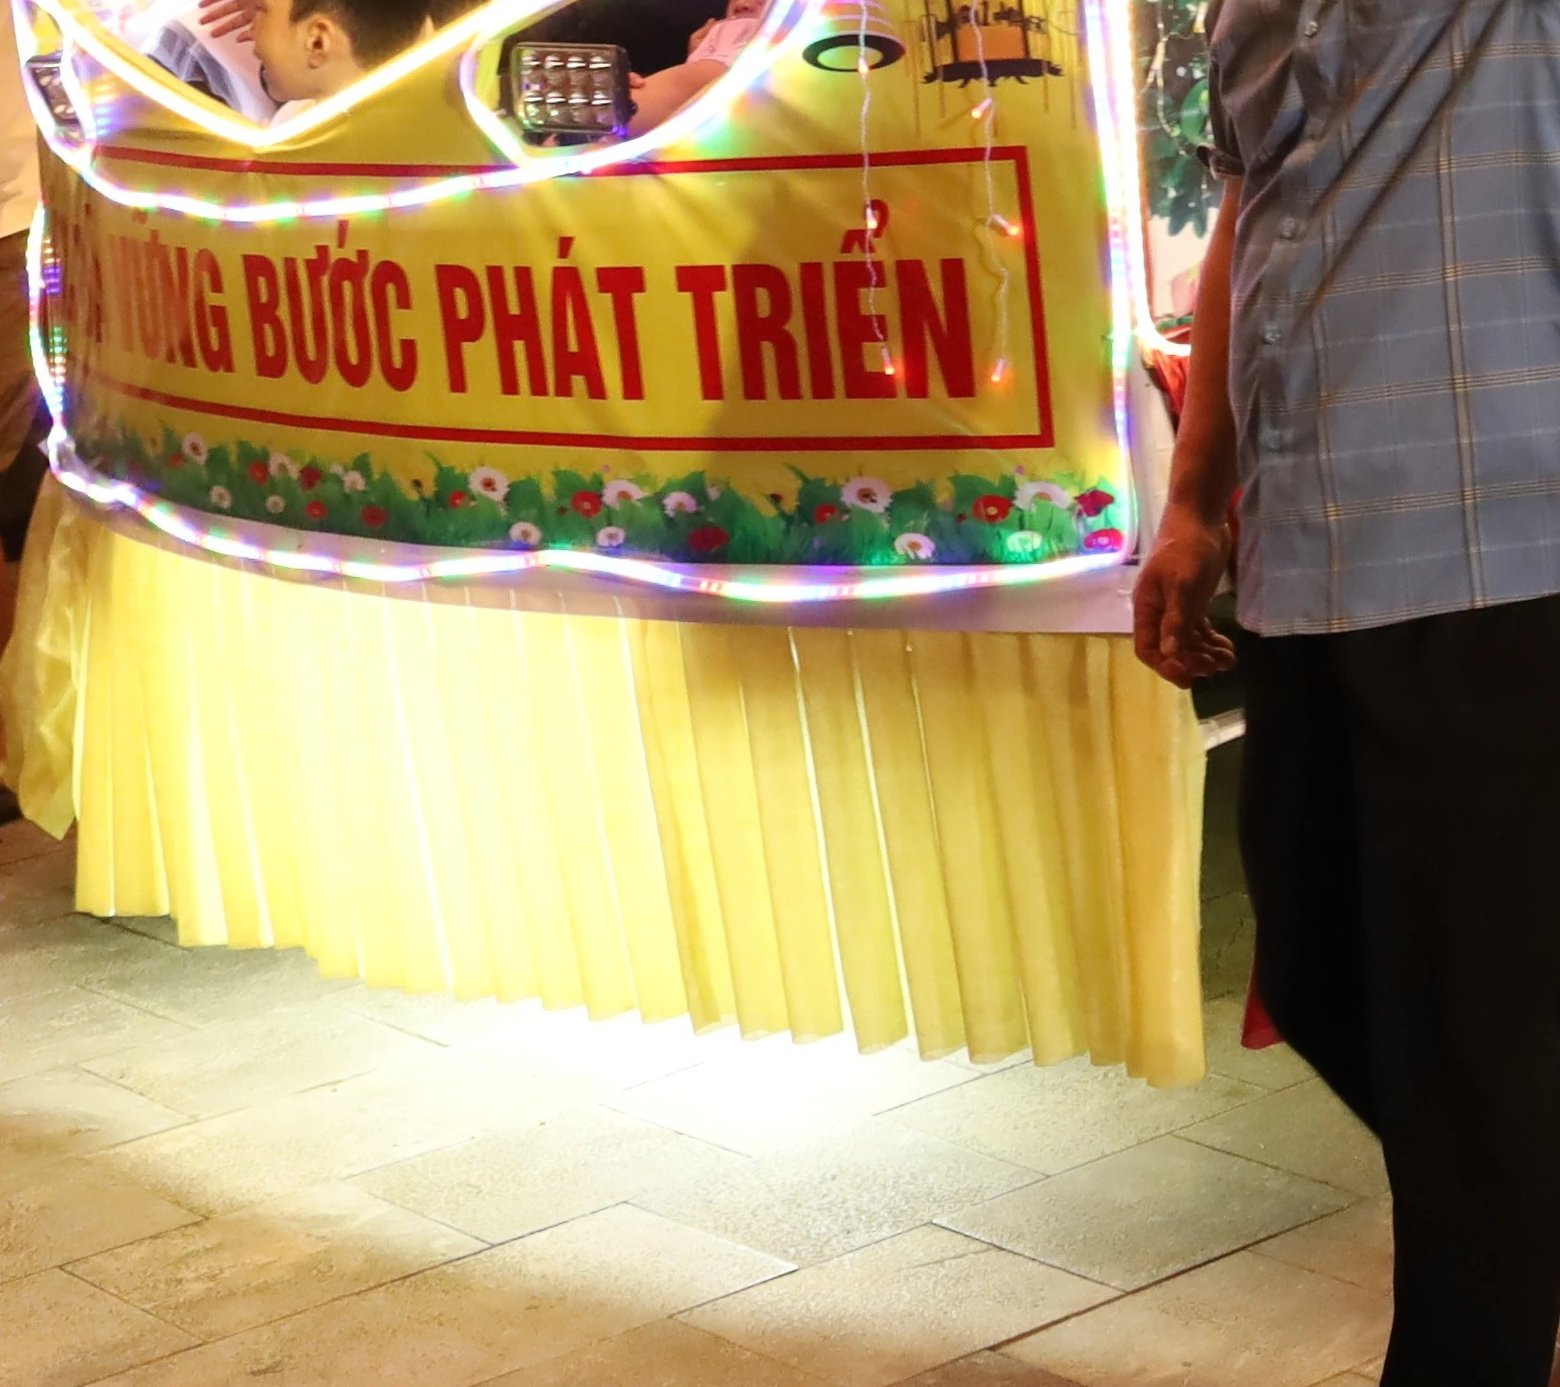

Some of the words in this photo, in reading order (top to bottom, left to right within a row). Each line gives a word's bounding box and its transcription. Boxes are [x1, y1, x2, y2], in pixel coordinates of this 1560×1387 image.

[242, 220, 419, 394] BƯỚC
[433, 235, 647, 402] PHÁT
[675, 197, 978, 402] TRIỂN
